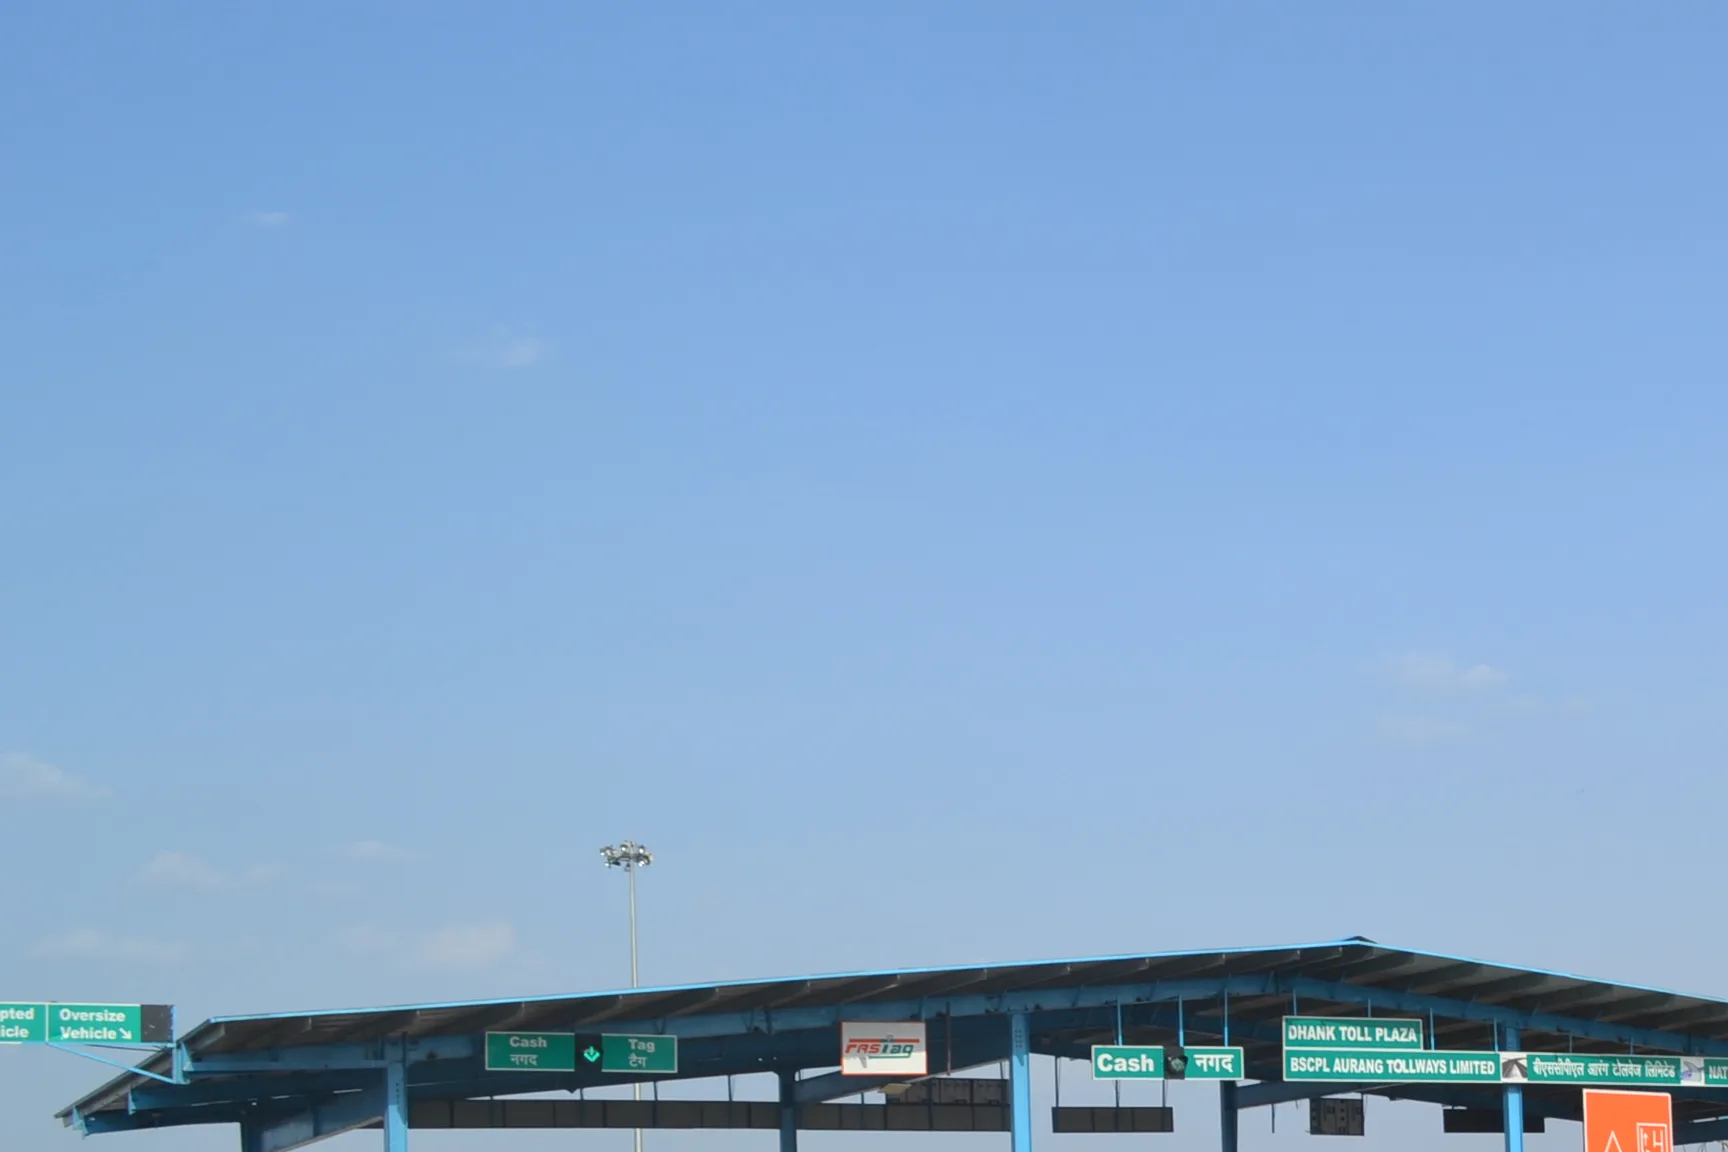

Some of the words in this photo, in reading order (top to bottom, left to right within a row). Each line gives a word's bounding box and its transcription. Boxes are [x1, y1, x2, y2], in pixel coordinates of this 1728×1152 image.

[60, 1008, 126, 1022] Oversize
[60, 1026, 117, 1040] Vehicle
[1288, 1025, 1336, 1041] DHANK
[1338, 1026, 1373, 1042] TOLL
[1376, 1027, 1418, 1042] PLAZA
[509, 1036, 548, 1048] Cash
[628, 1039, 656, 1052] Tag
[510, 1053, 539, 1066] नगद
[628, 1053, 648, 1067] टैग
[1097, 1053, 1155, 1072] Cash
[1193, 1054, 1235, 1073] नगद
[1290, 1057, 1331, 1073] BSCPL
[1333, 1058, 1384, 1074] AURANG
[1386, 1059, 1447, 1075] TOLLWAYS
[1449, 1060, 1496, 1075] LIMITED
